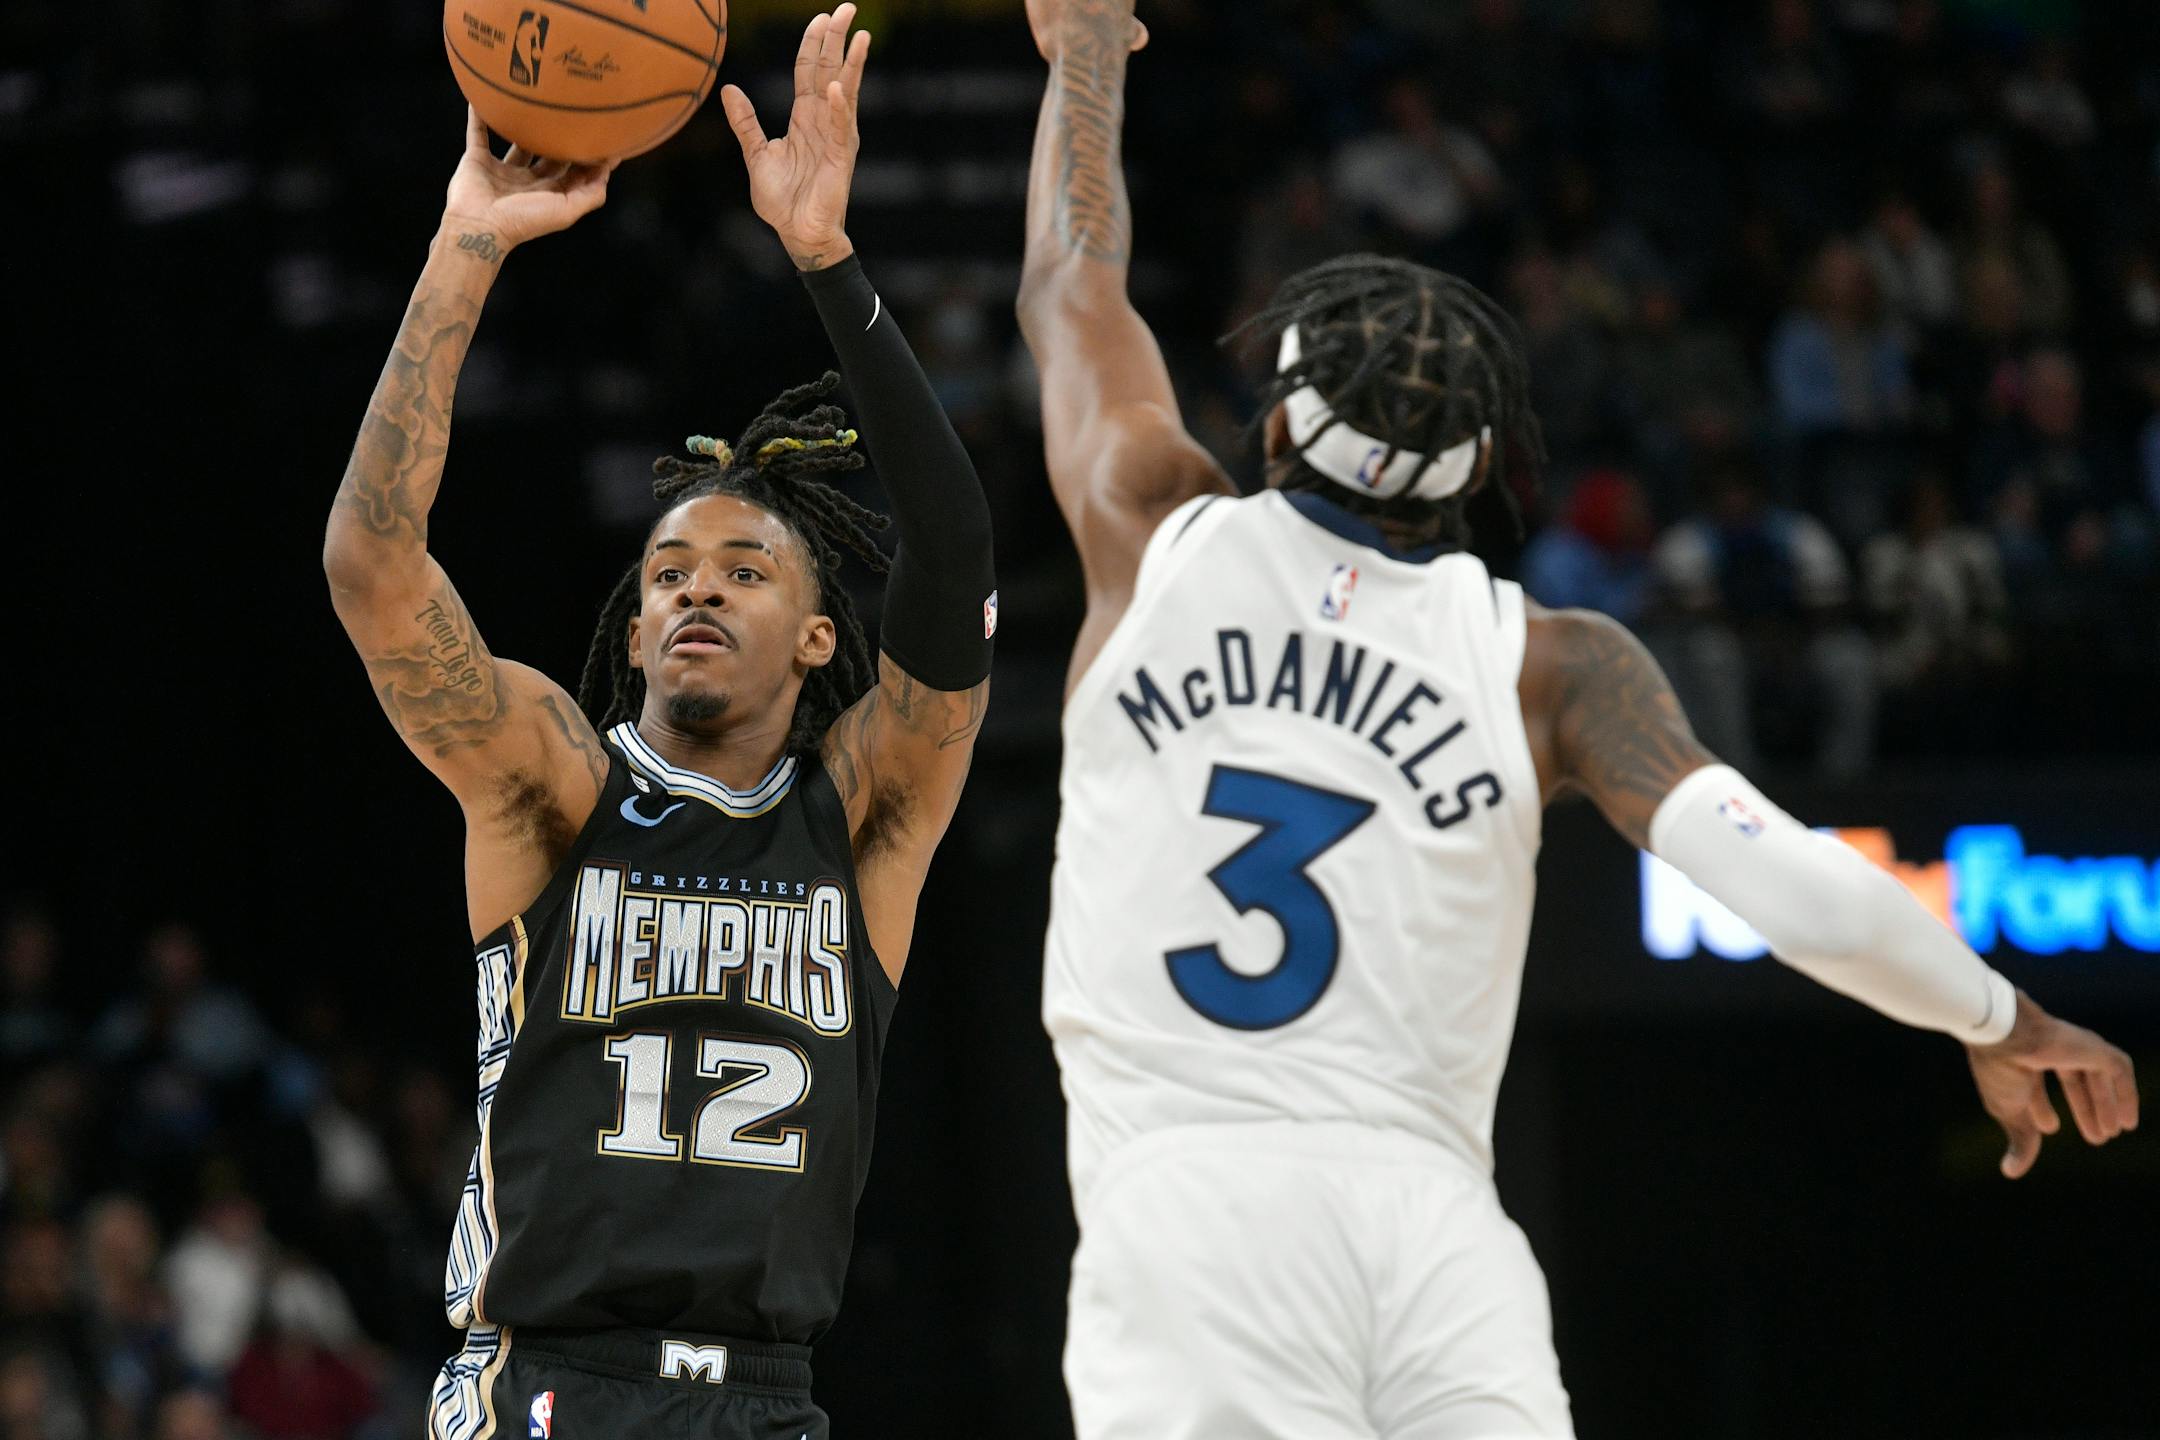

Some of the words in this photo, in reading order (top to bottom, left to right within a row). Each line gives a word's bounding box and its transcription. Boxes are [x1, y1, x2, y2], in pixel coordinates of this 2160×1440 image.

[1116, 628, 1502, 829] McDANIELS
[560, 860, 853, 1038] MEMPHIS
[630, 871, 806, 896] GRIZZLIES
[1164, 763, 1377, 1031] 3
[597, 1030, 813, 1173] 12
[530, 1426, 543, 1438] NBA
[659, 1339, 728, 1384] M
